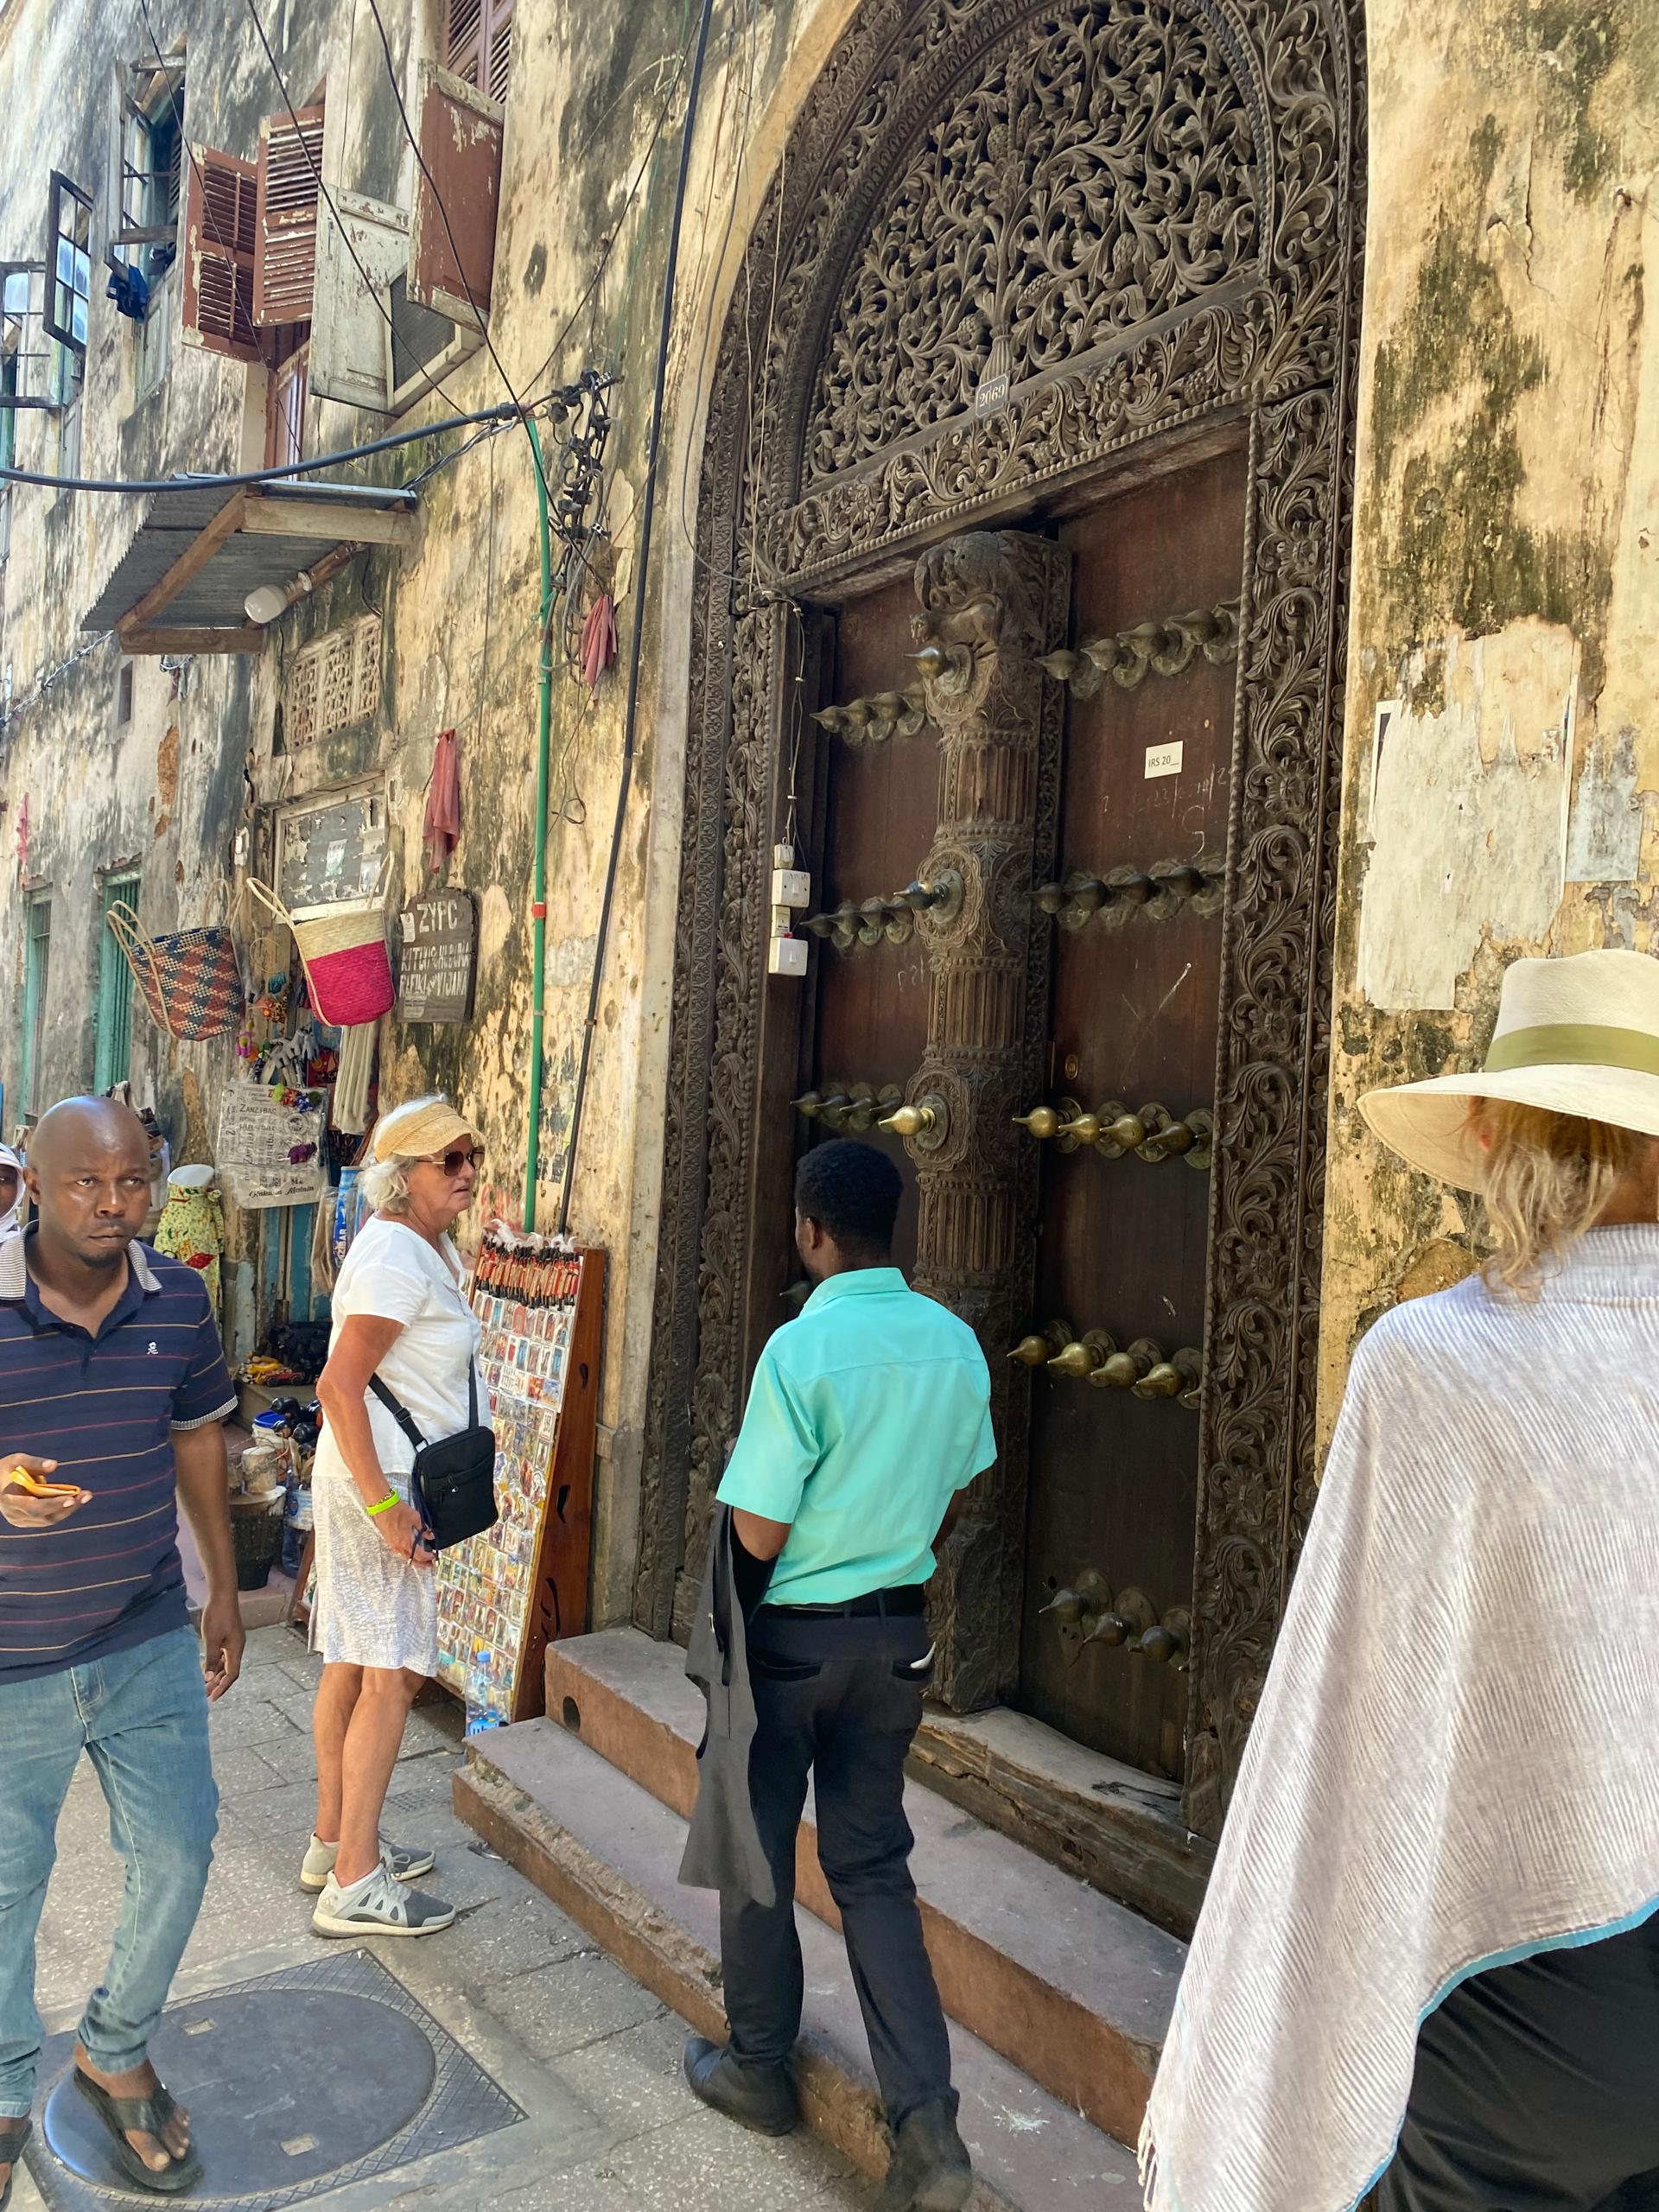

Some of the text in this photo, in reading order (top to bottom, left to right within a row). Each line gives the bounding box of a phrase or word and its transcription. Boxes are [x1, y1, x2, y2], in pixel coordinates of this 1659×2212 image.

[979, 384, 1005, 408] 2069
[1148, 757, 1160, 767] IRS
[399, 973, 427, 998] RAFIKI
[436, 970, 467, 995] VIJANA
